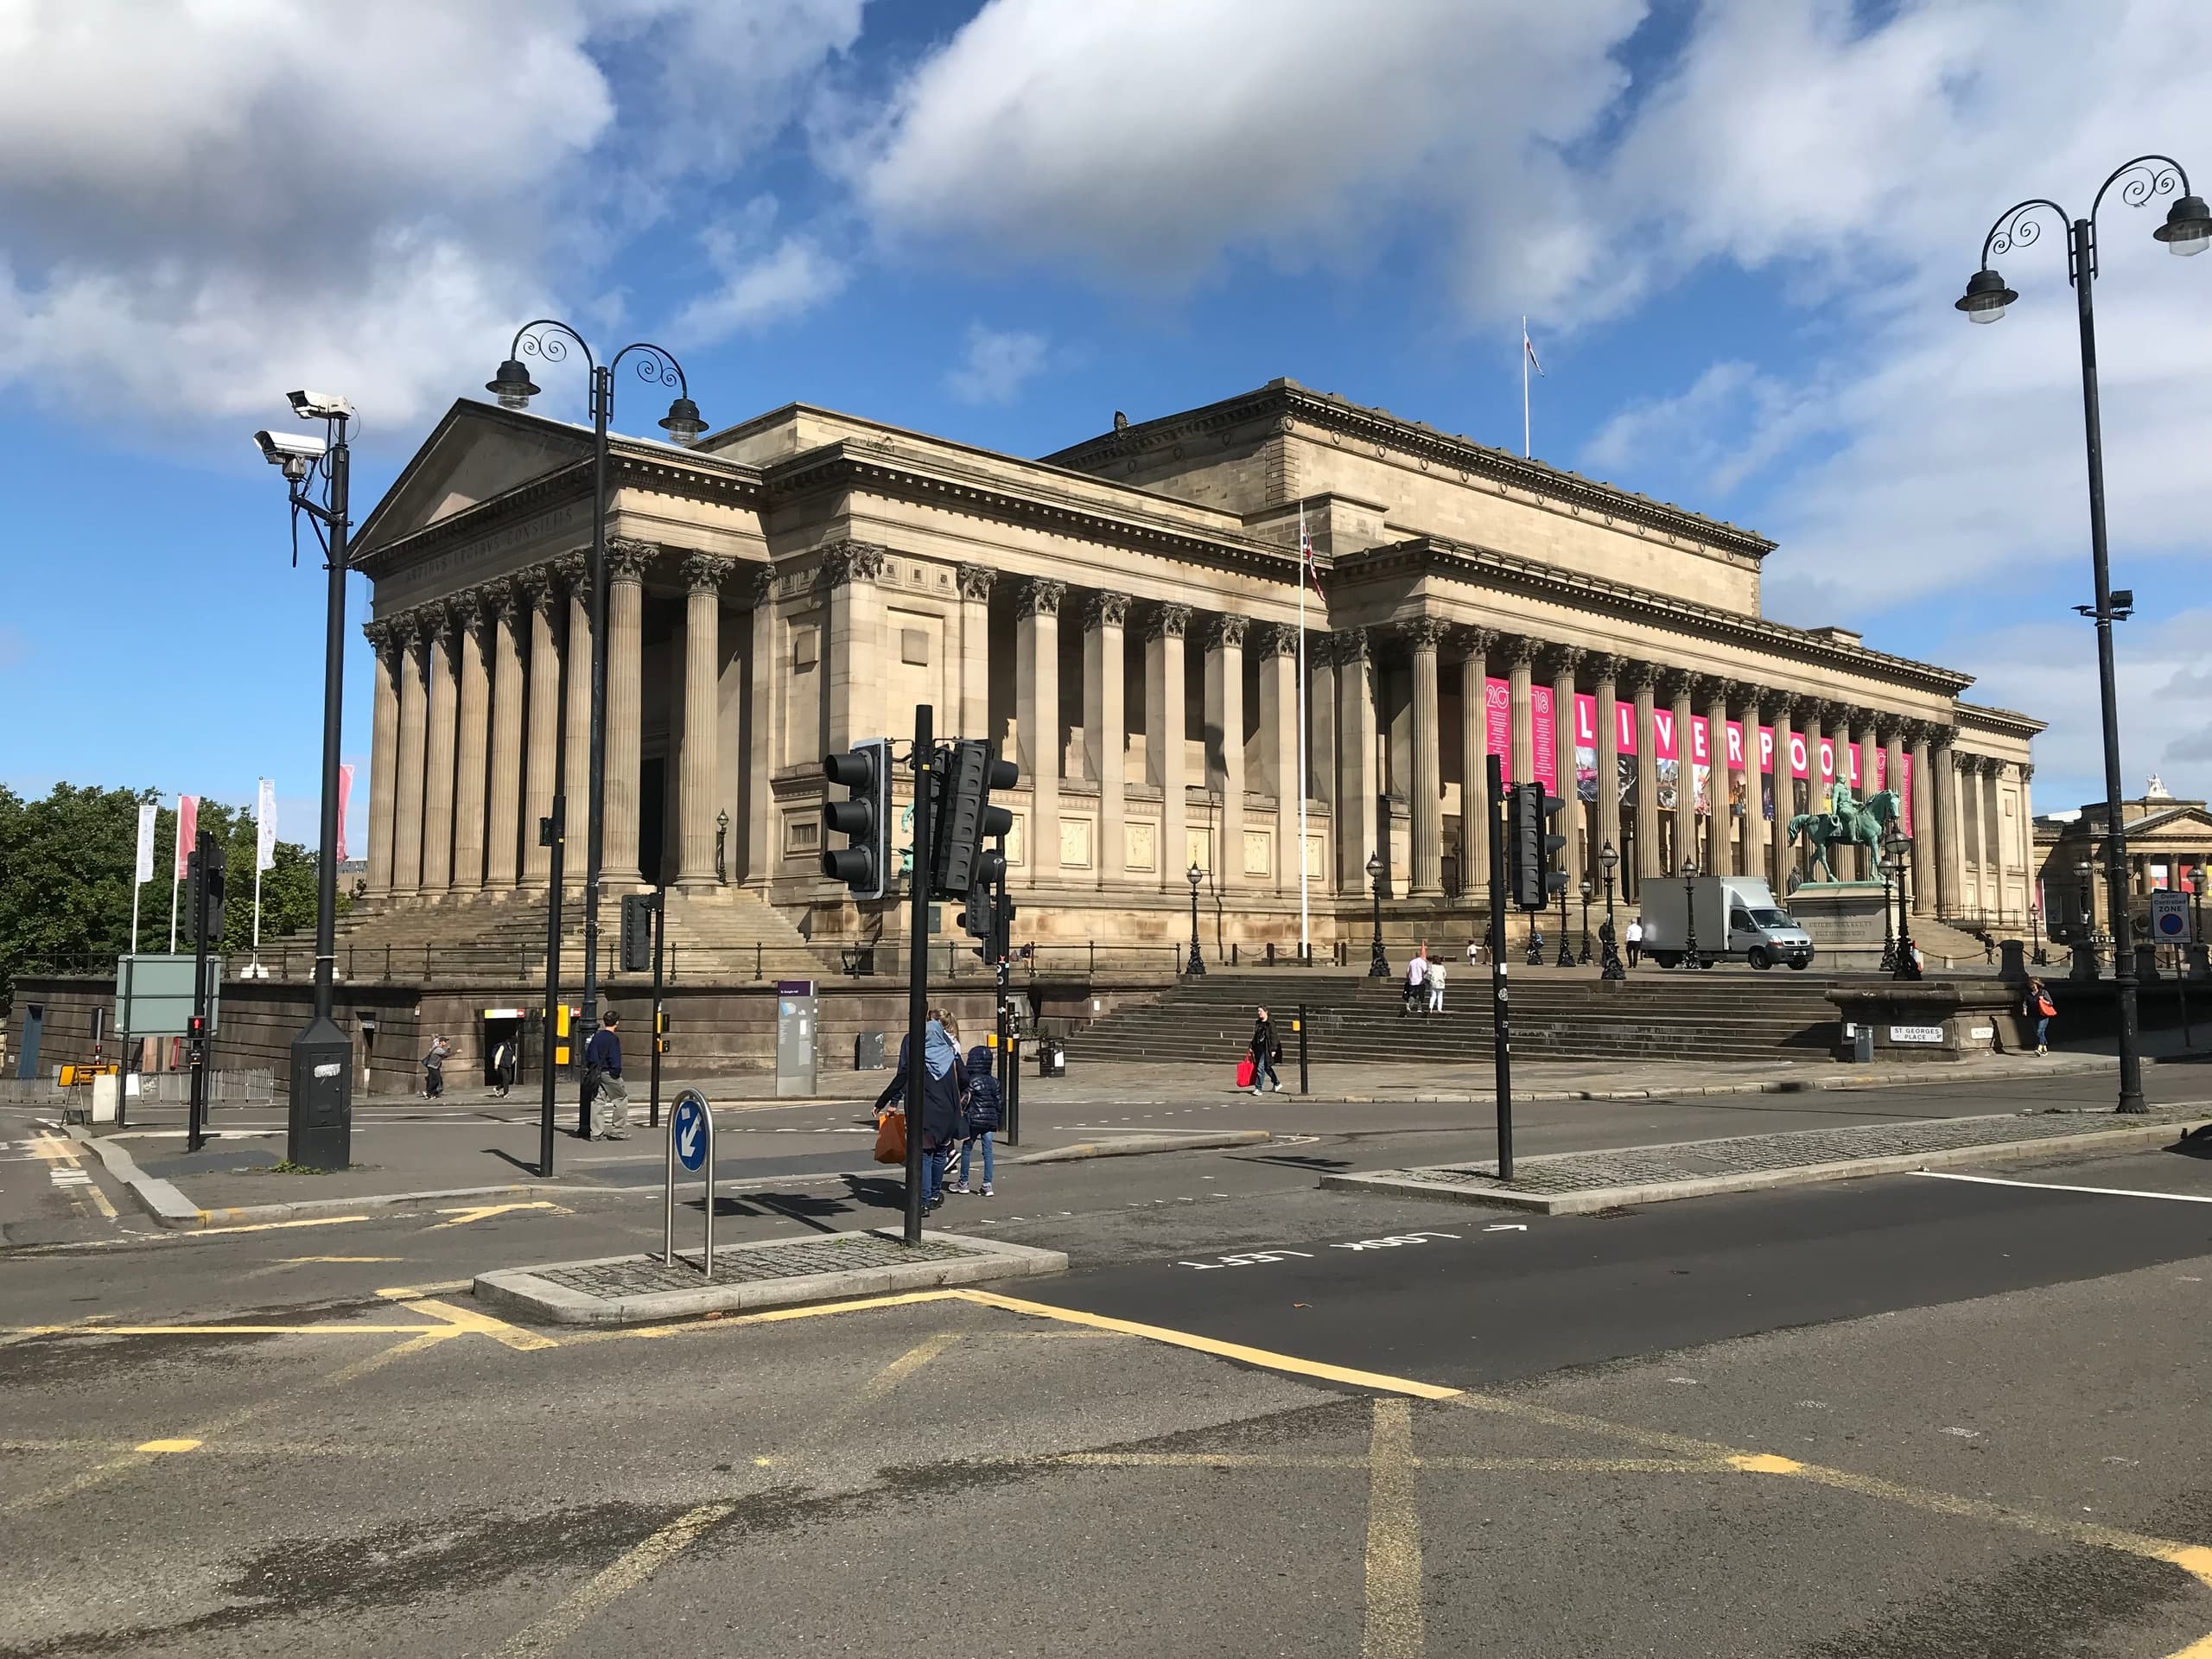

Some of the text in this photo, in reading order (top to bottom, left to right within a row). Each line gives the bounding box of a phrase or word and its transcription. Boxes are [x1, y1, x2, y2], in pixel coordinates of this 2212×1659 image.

[1579, 700, 1858, 780] LIVERPOOL
[1177, 1231, 1463, 1270] LOOK LEFT
